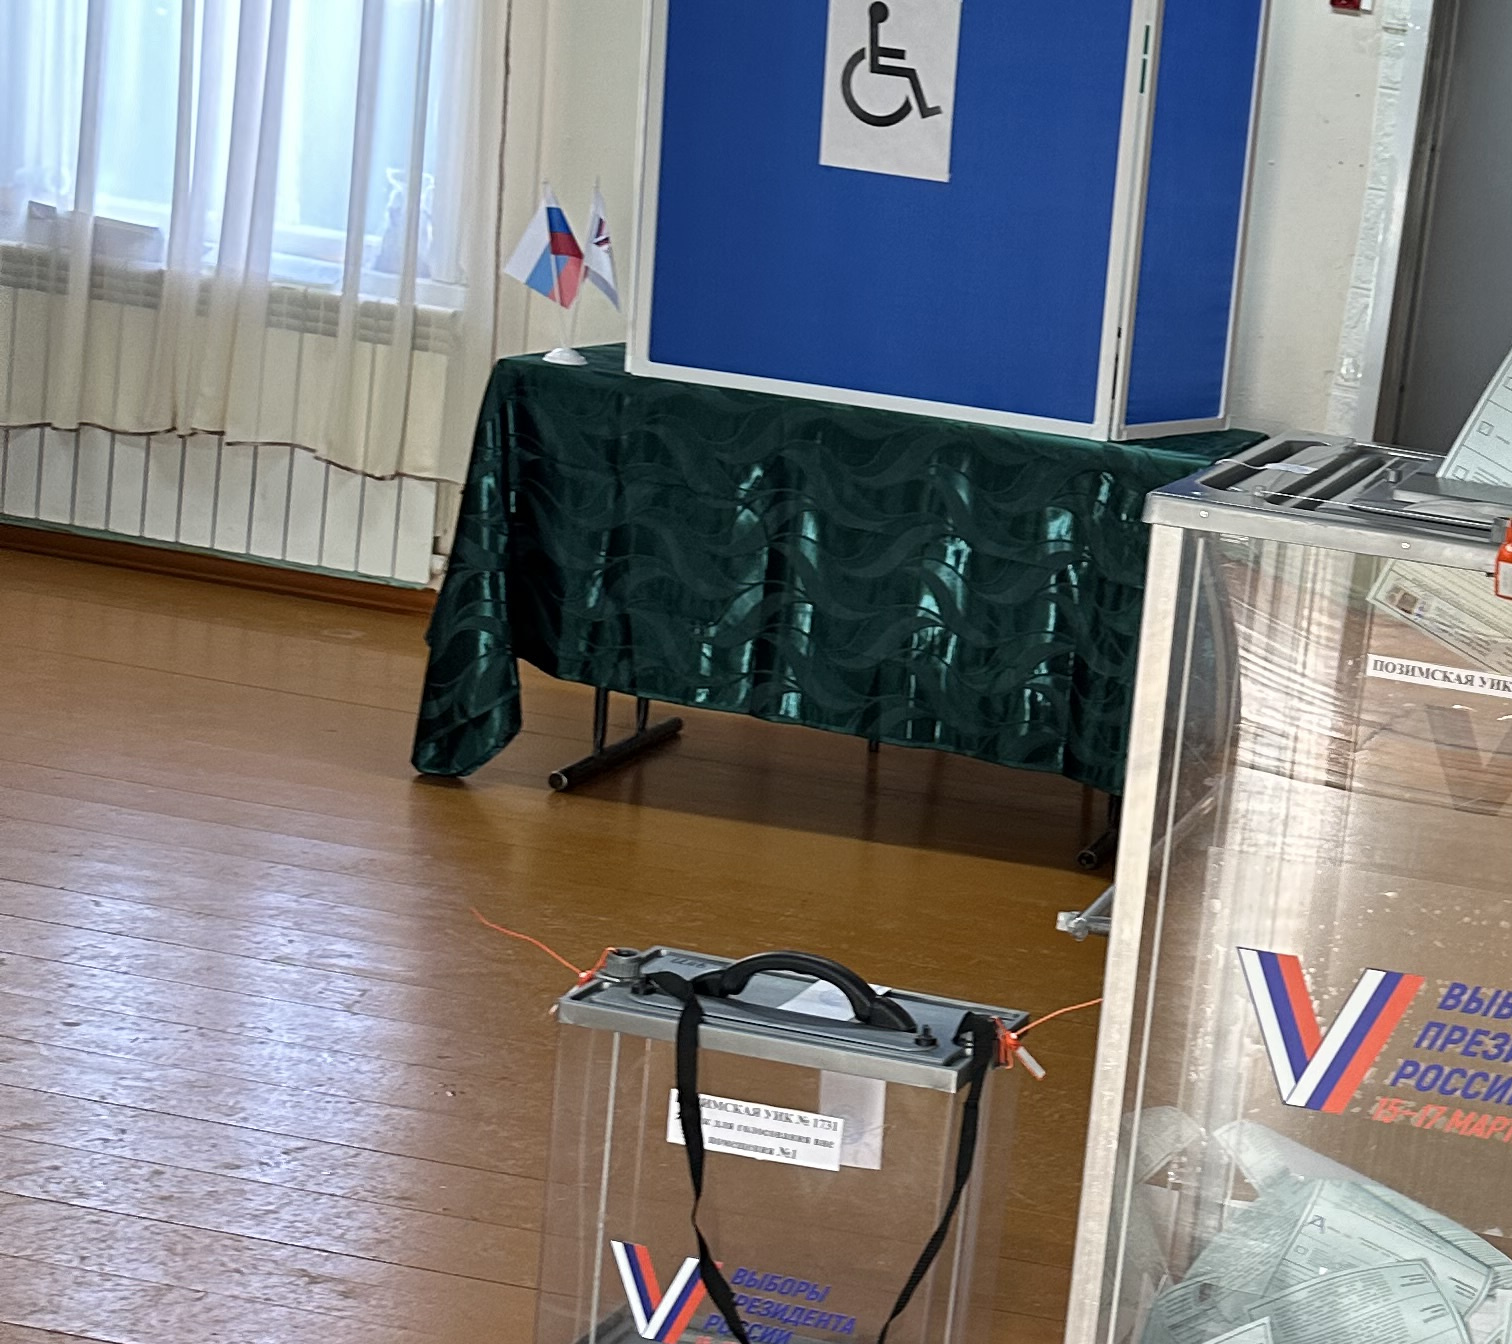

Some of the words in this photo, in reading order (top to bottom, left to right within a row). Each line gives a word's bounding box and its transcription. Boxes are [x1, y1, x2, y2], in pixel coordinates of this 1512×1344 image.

[1371, 658, 1475, 688] ПОЗИМСКАЯ
[763, 1109, 794, 1124] УИК
[812, 1118, 838, 1132] 1731
[730, 1266, 832, 1303] ВЫБОРЫ
[734, 1292, 857, 1336] РЕЗИДЕНТА
